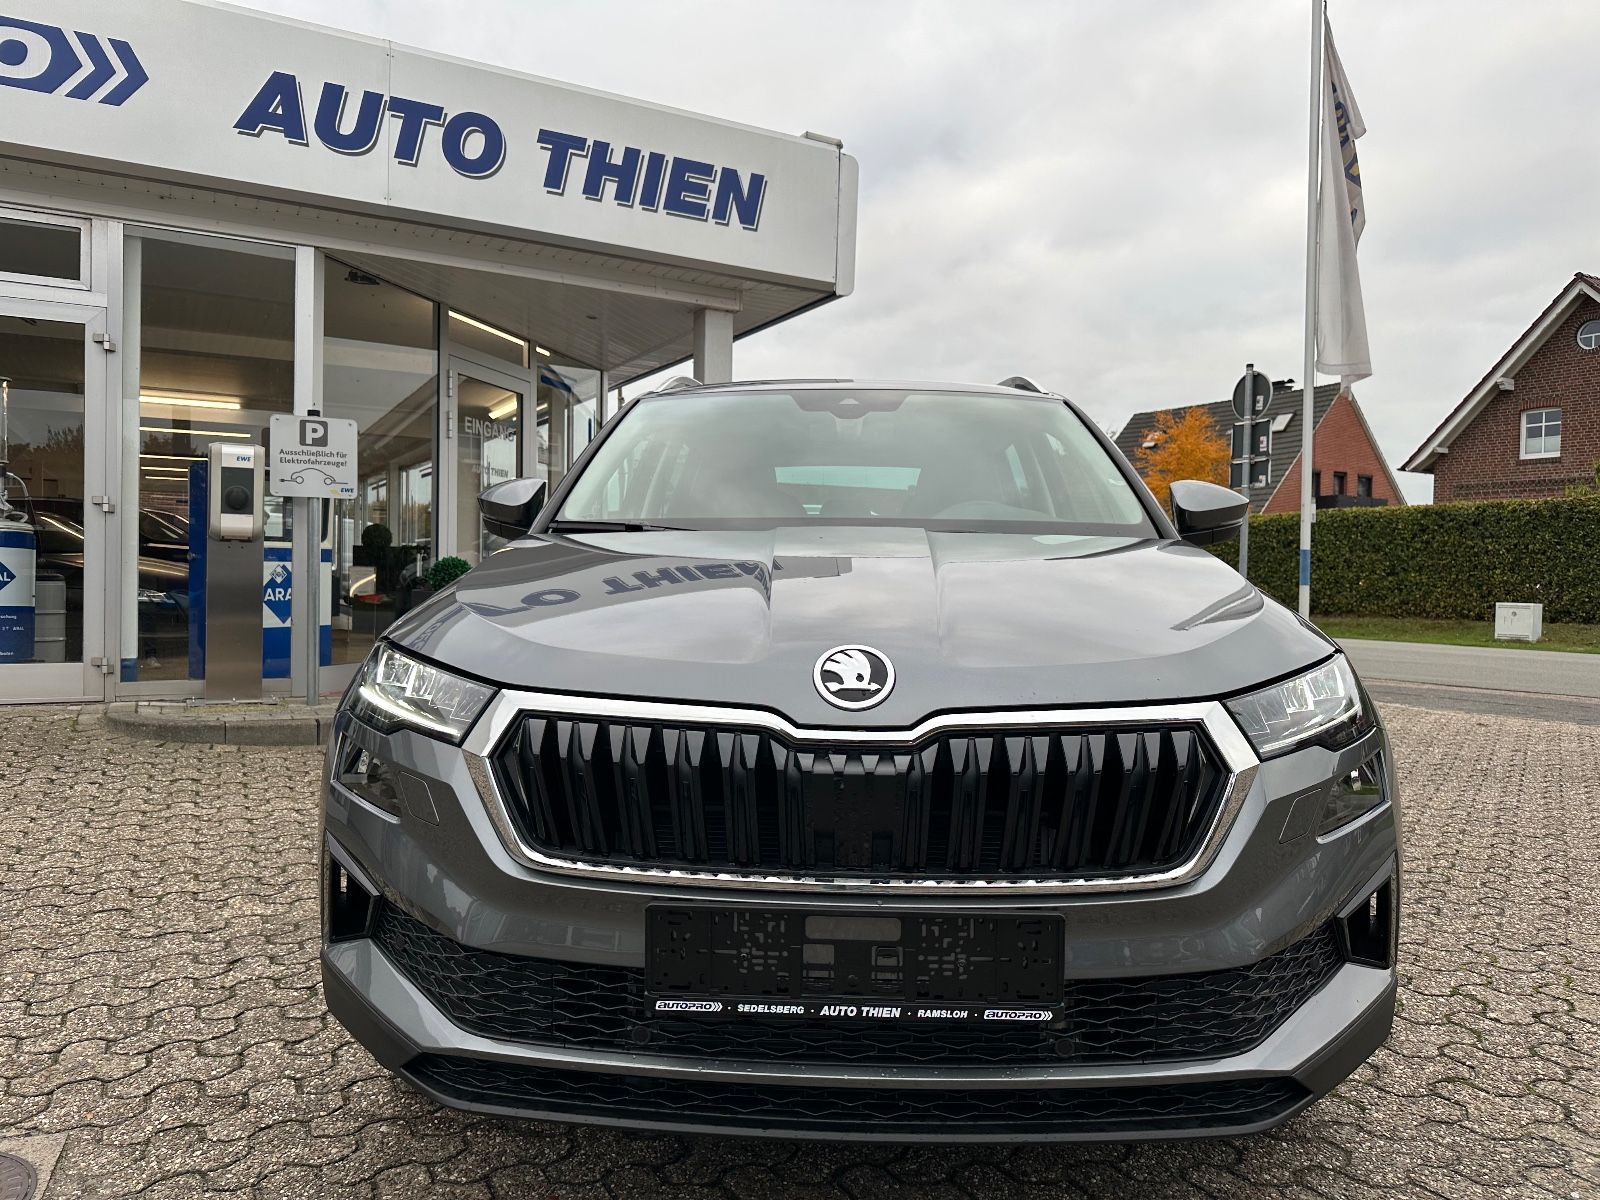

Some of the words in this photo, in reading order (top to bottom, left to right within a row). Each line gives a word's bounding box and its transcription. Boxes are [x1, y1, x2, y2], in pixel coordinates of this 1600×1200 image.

[232, 70, 506, 179] AUTO
[537, 128, 767, 232] THIEN
[305, 422, 325, 444] P
[279, 449, 335, 458] Ausschließlich
[279, 457, 347, 467] Elektrofahrzeuge!
[737, 1004, 804, 1014] SEDELSBERG
[819, 1005, 857, 1016] AUTO
[861, 1006, 901, 1018] THIEN
[917, 1009, 968, 1019] RAMSLOH
